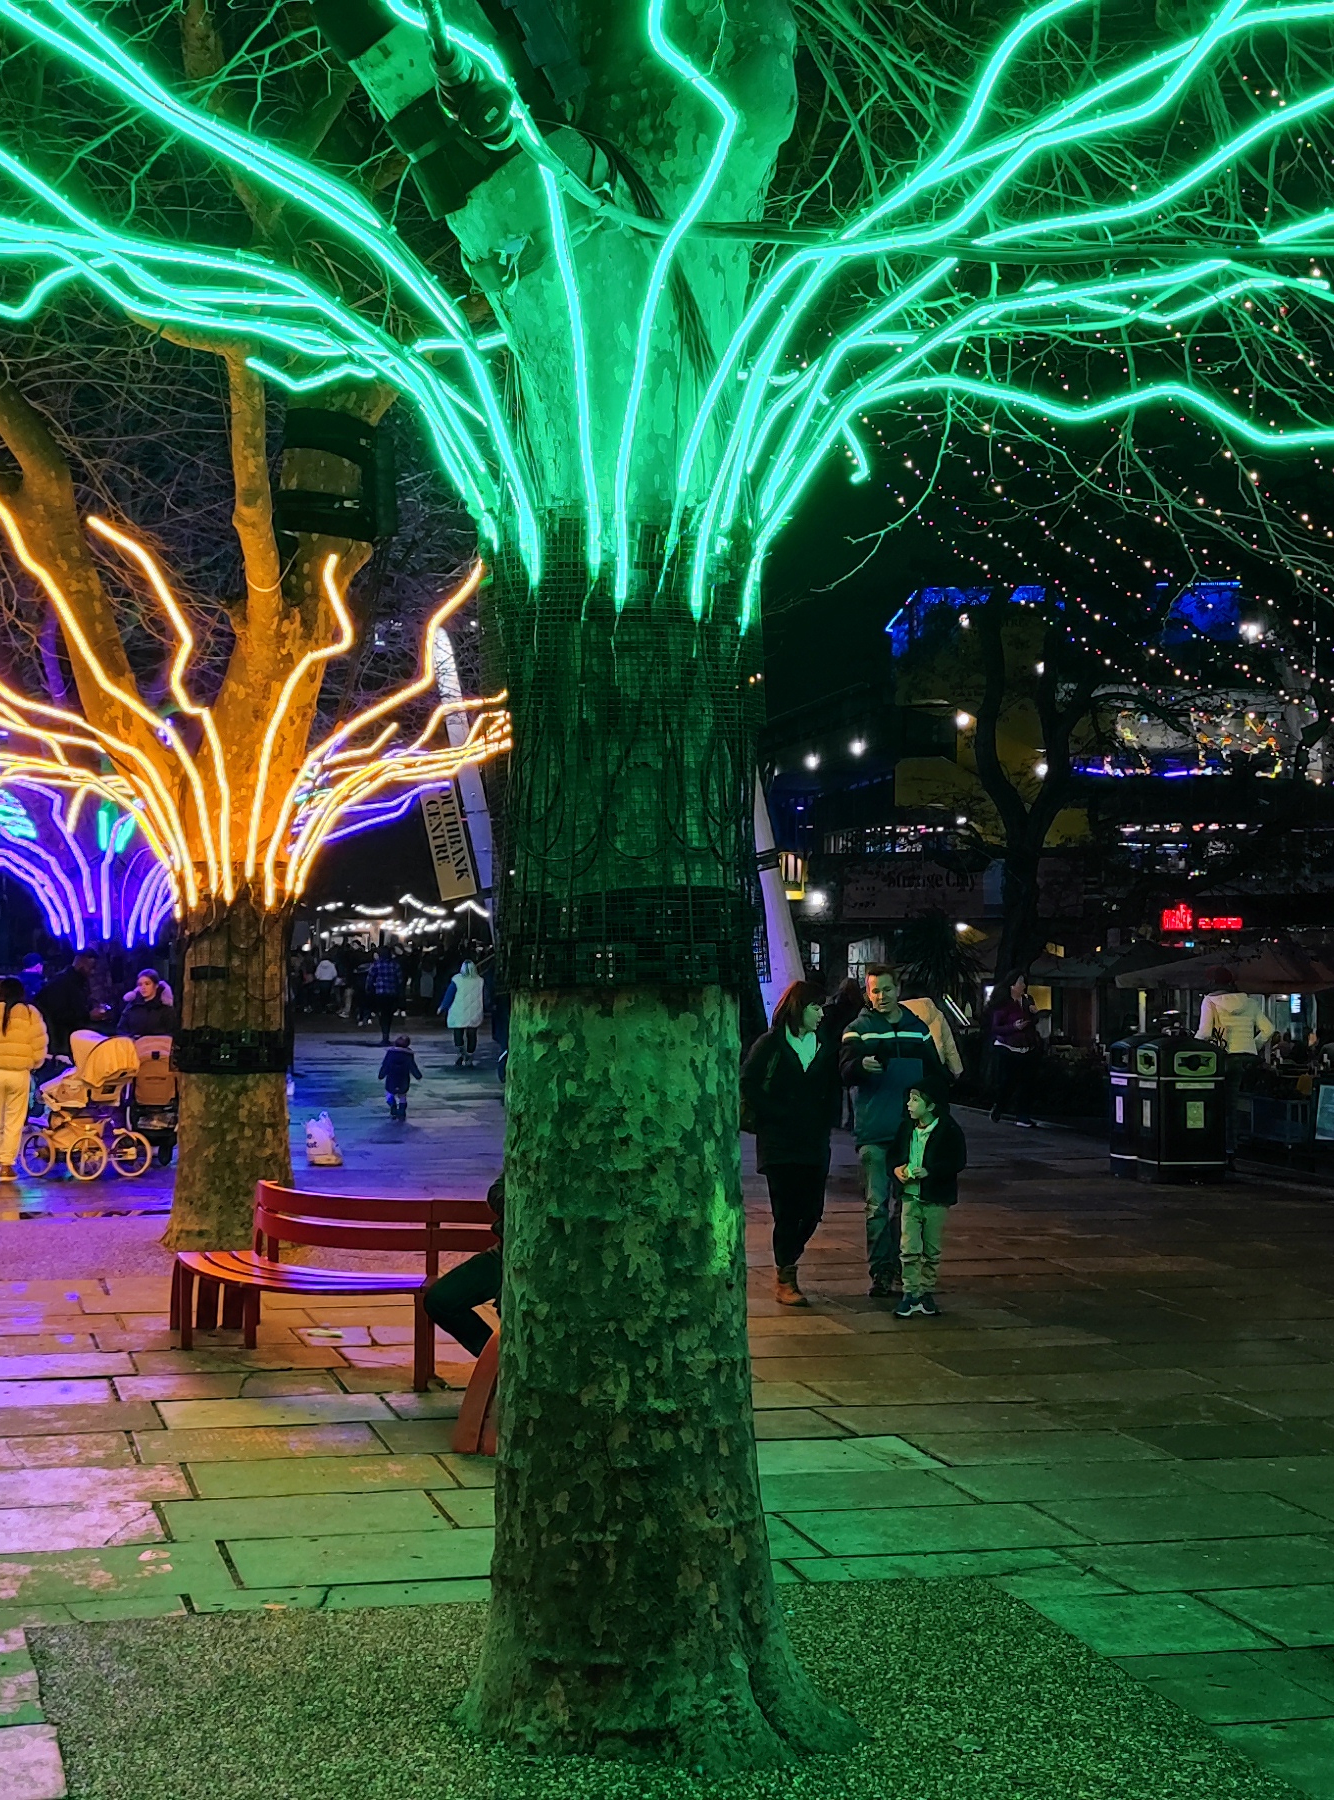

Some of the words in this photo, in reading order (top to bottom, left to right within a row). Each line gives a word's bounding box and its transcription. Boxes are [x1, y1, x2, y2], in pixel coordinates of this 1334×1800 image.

[426, 799, 451, 867] CENTRE
[439, 788, 470, 882] OUTHBANK
[887, 870, 943, 889] Strange
